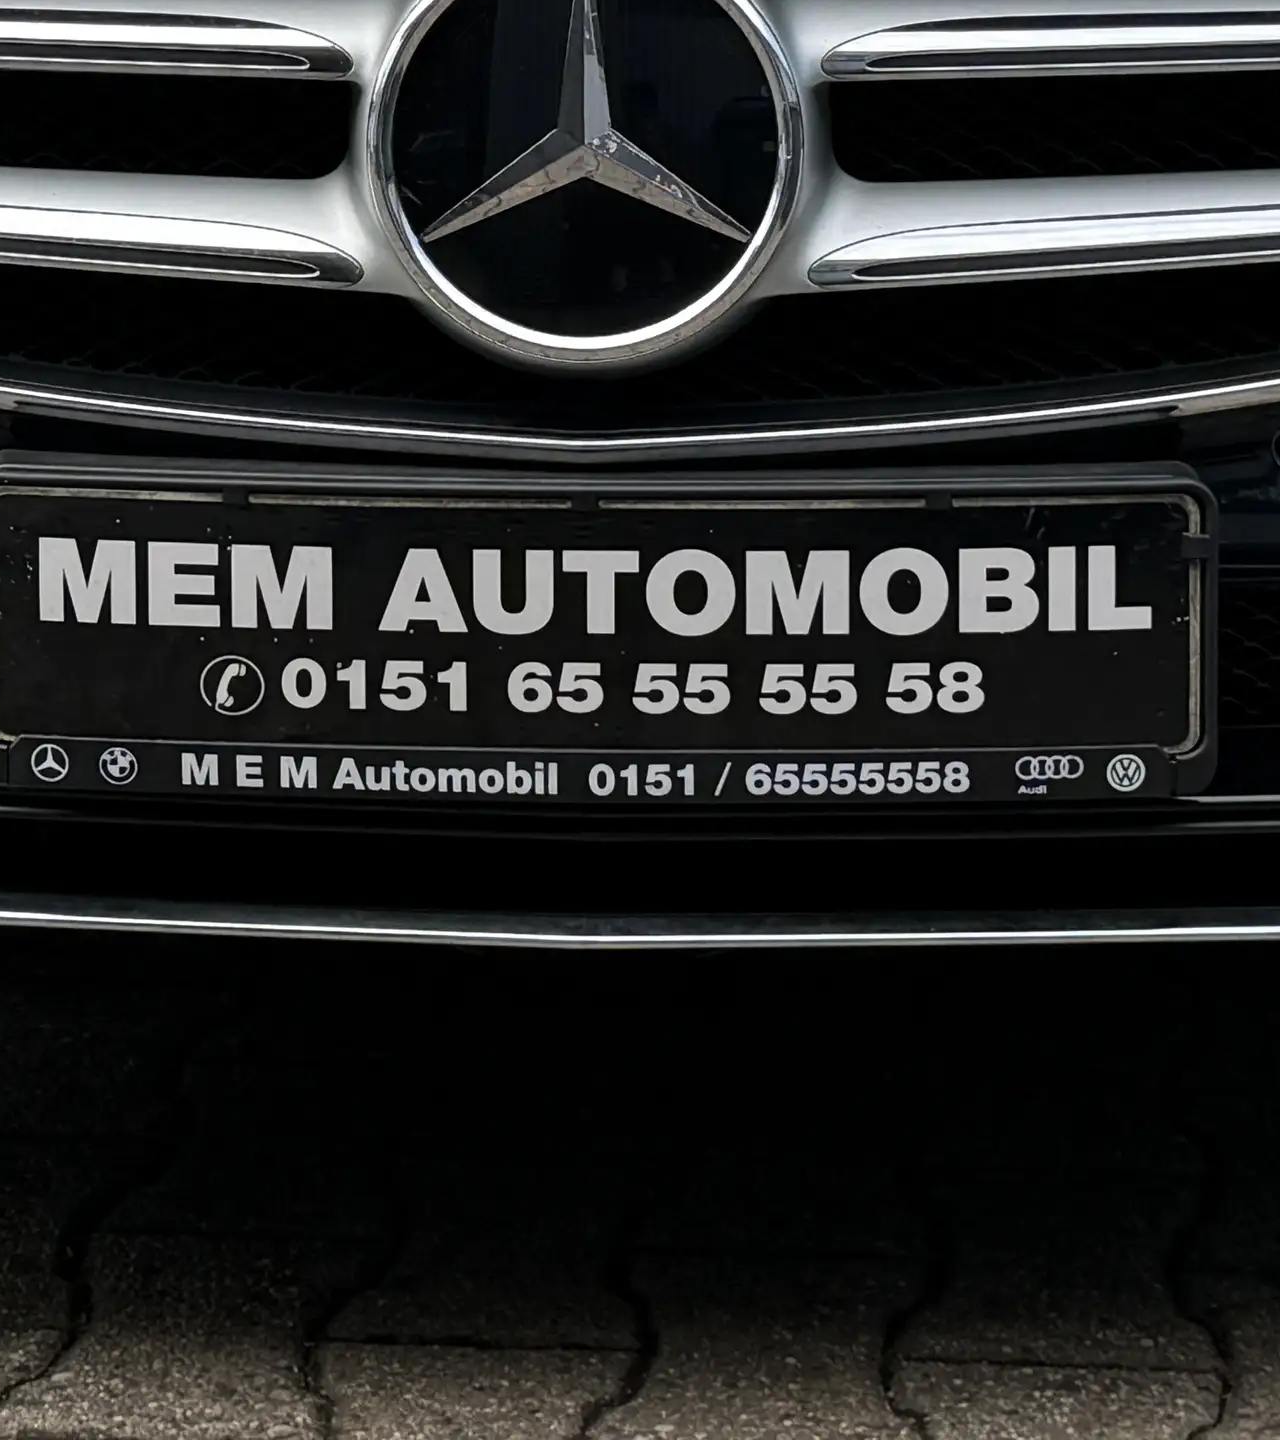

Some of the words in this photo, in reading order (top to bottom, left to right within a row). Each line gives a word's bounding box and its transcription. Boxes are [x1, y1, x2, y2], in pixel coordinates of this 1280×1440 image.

[38, 536, 334, 631] MEM
[377, 545, 1153, 637] AUTOMOBIL
[280, 656, 469, 712] 0151
[506, 661, 604, 714] 65
[632, 663, 731, 715] 55
[758, 663, 858, 715] 55
[885, 661, 985, 715] 58
[332, 757, 558, 795] Automobil
[588, 763, 695, 797] 0151
[745, 761, 970, 796] 65555558
[1017, 785, 1048, 795] Audi
